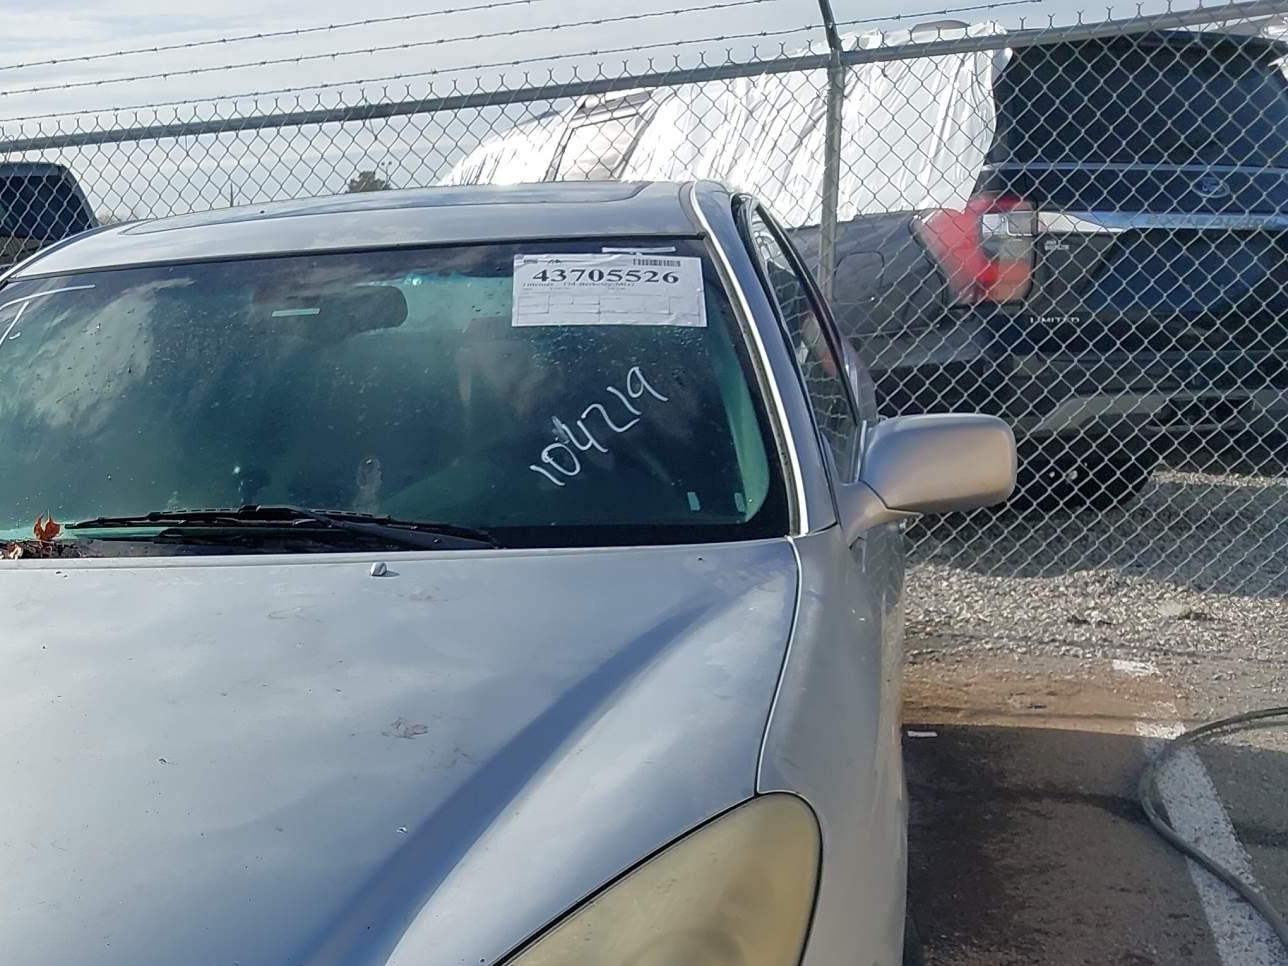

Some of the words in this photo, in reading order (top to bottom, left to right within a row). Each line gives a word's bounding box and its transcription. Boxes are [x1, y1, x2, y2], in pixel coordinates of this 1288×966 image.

[532, 268, 680, 284] 43705526
[1029, 316, 1080, 324] LMITD
[529, 366, 669, 487] 104219
